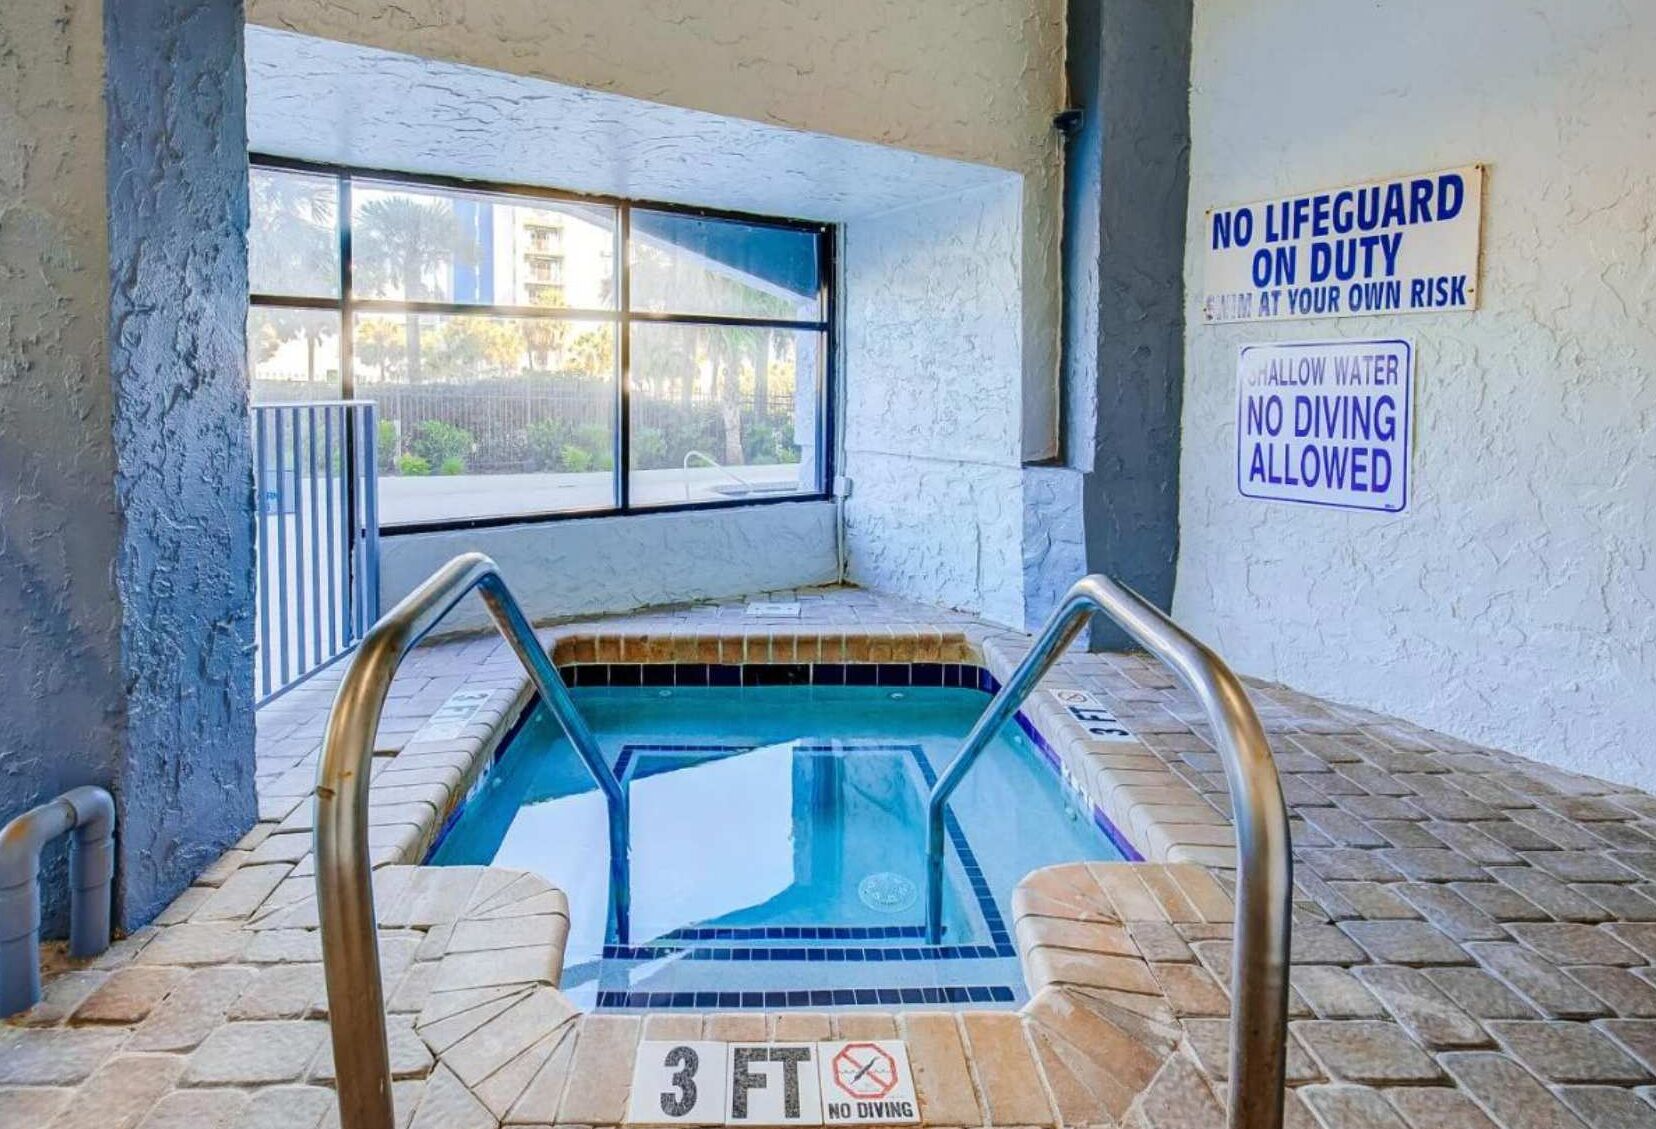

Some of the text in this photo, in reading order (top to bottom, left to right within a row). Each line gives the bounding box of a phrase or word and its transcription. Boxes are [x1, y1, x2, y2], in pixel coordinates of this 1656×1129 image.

[1212, 174, 1464, 250] NO LIFEGUARD
[1252, 232, 1403, 288] ON DUTY
[1258, 290, 1282, 317] AT
[1288, 285, 1341, 316] YOUR
[1349, 280, 1401, 312] OWN
[1410, 275, 1466, 308] RISK
[1334, 354, 1399, 386] WATER
[1247, 395, 1397, 442] NO DIVING
[1249, 442, 1393, 493] ALLOWED
[660, 1046, 812, 1119] 3 FT
[828, 1101, 914, 1119] NO DIVING
